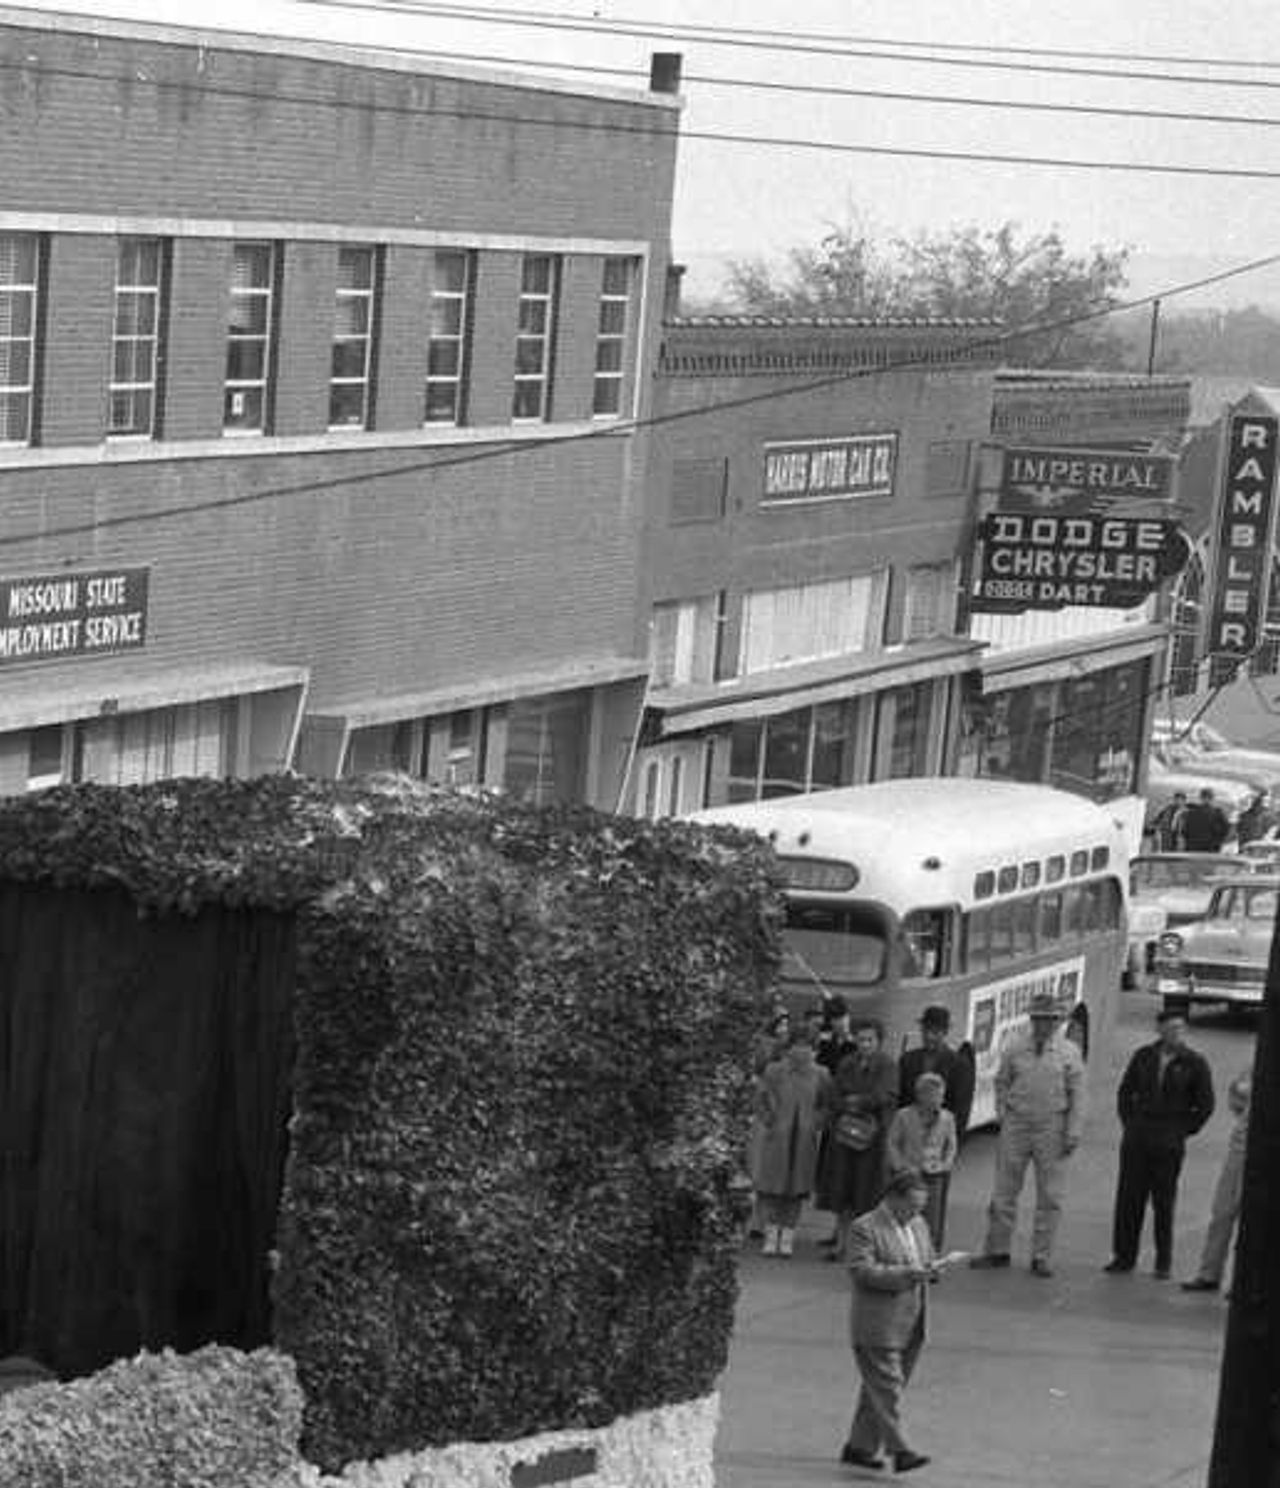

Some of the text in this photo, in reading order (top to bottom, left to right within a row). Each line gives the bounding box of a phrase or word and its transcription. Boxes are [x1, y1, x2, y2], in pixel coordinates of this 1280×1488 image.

[1011, 457, 1159, 489] IMPERIAL
[991, 515, 1166, 549] DODGE
[1221, 424, 1268, 646] RAMBLER
[991, 549, 1157, 581] CHRYSLER
[8, 575, 127, 618] MISSOURI STATE
[1039, 583, 1107, 604] DART
[84, 611, 143, 647] SERVICE
